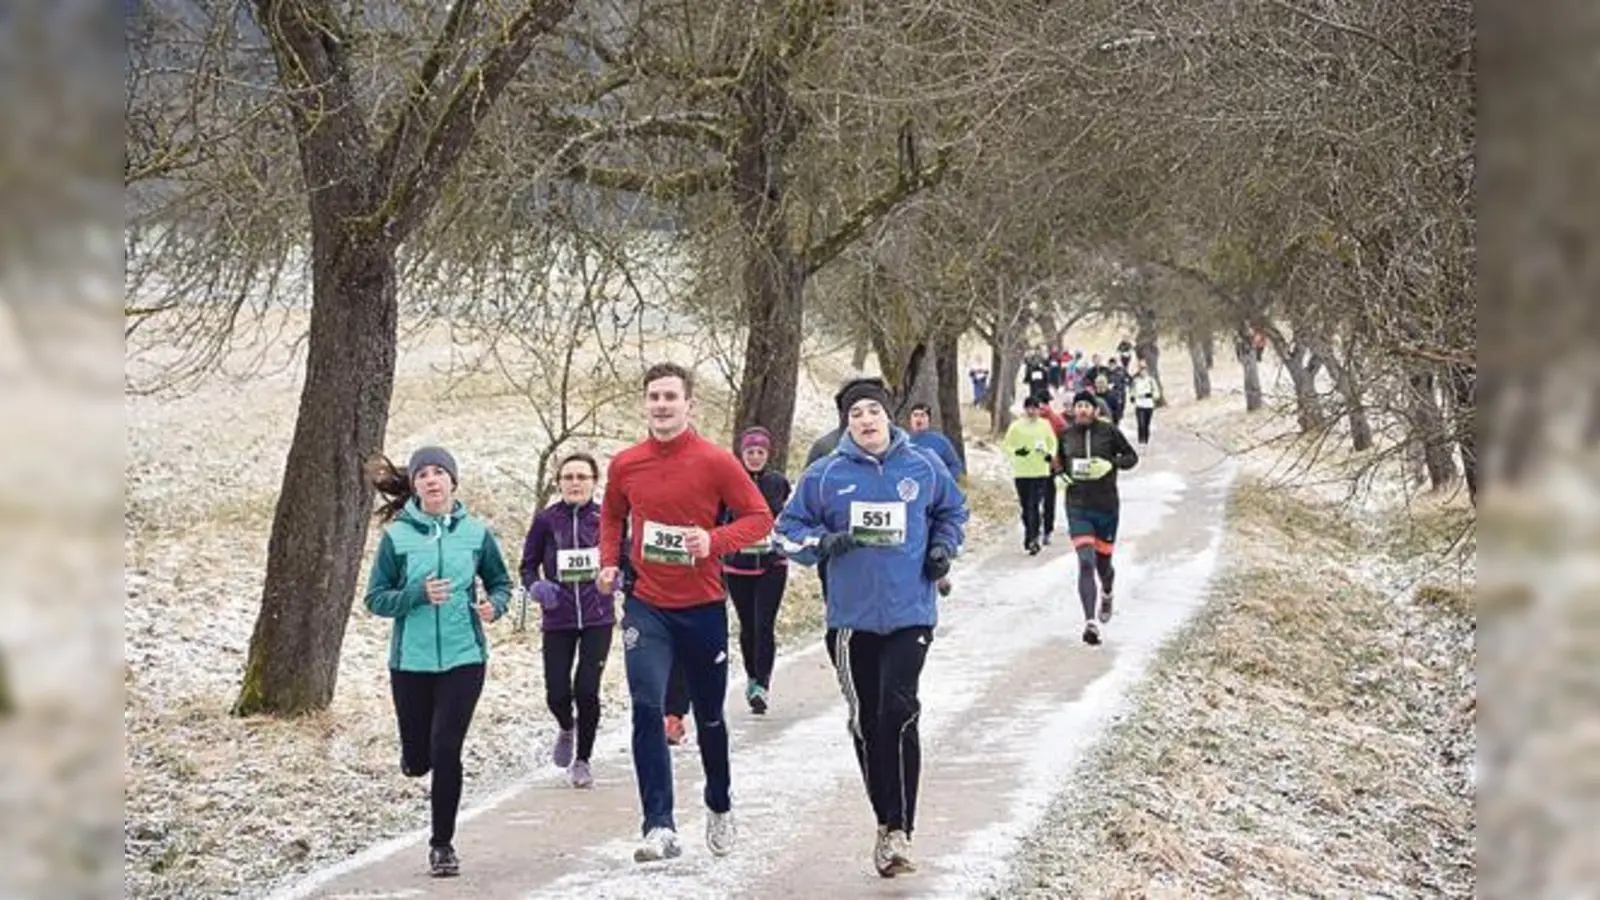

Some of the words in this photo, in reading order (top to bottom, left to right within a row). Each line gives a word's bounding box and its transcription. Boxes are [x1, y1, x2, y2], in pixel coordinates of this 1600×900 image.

[862, 510, 891, 527] 551
[655, 530, 683, 549] 392
[567, 554, 592, 568] 201
